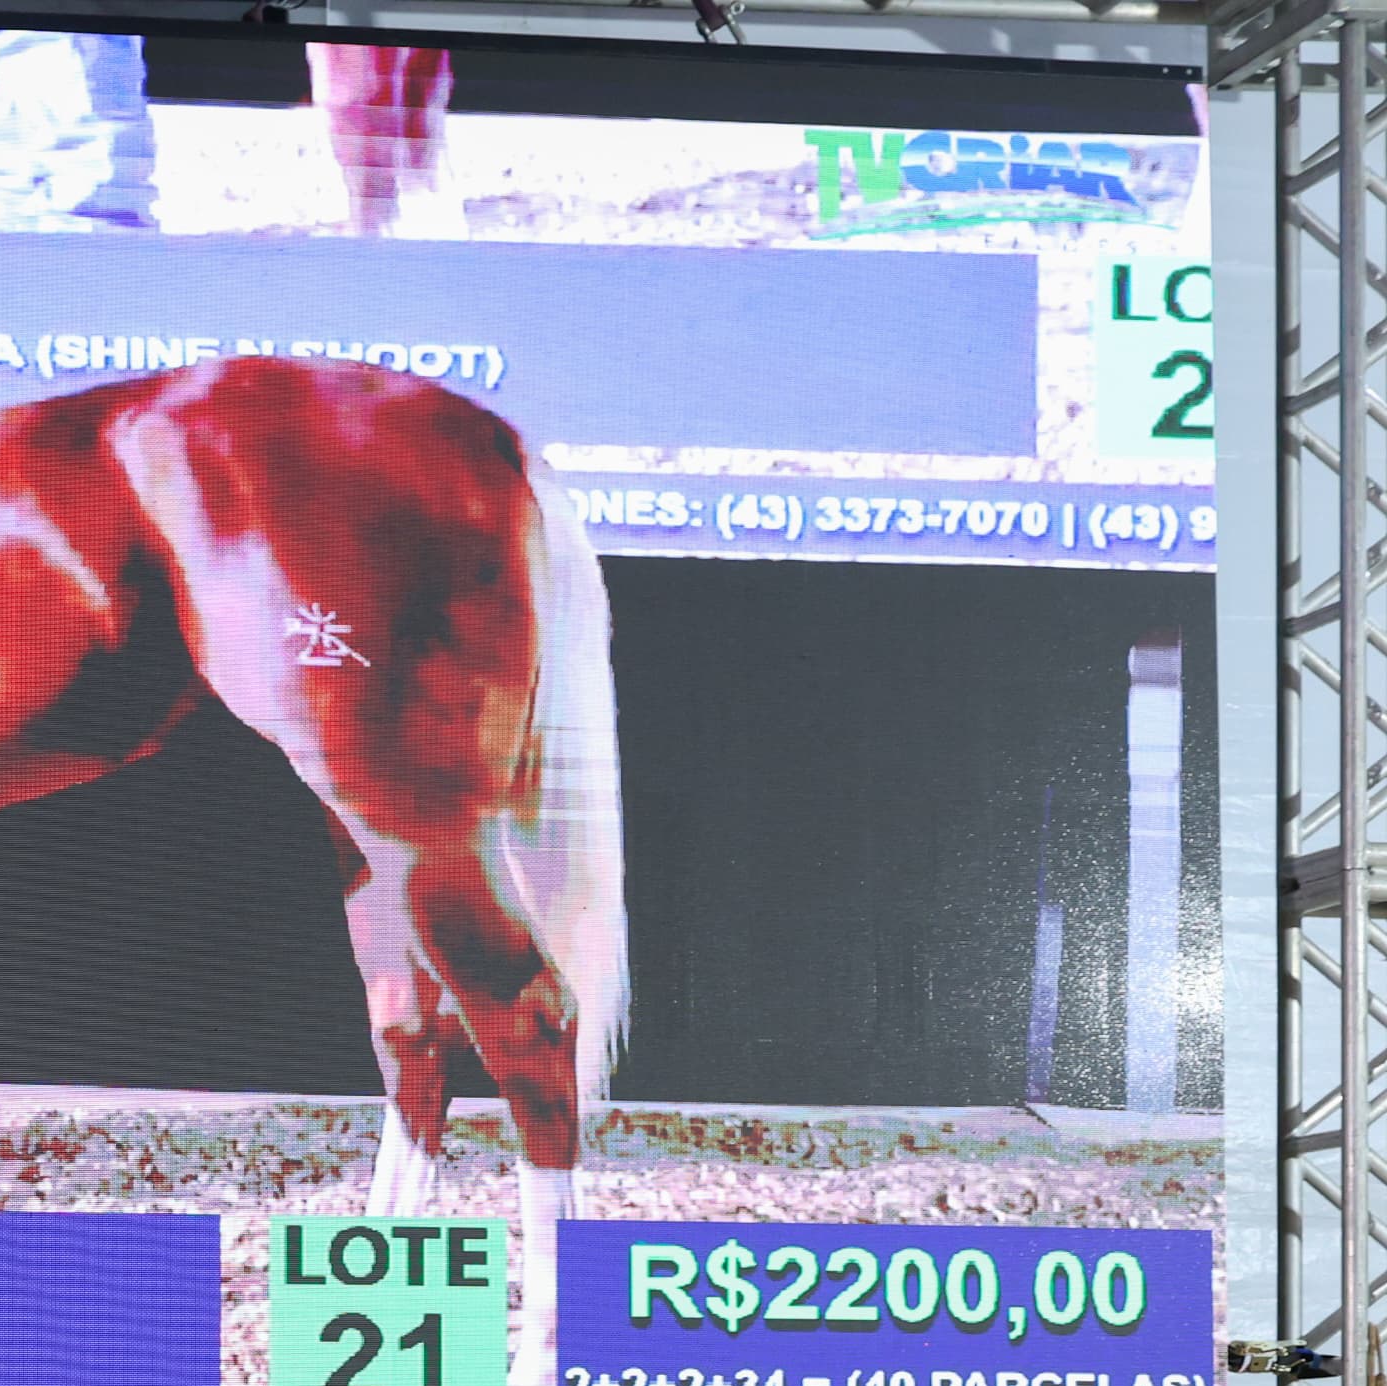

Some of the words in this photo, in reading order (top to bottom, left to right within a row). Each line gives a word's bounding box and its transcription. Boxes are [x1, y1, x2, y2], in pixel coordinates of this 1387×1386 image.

[717, 494, 804, 541] (43)
[815, 497, 1049, 537] 3373-7070
[1088, 504, 1180, 550] (43)
[285, 1225, 489, 1288] LOTE
[630, 1239, 1146, 1339] R$2200,00
